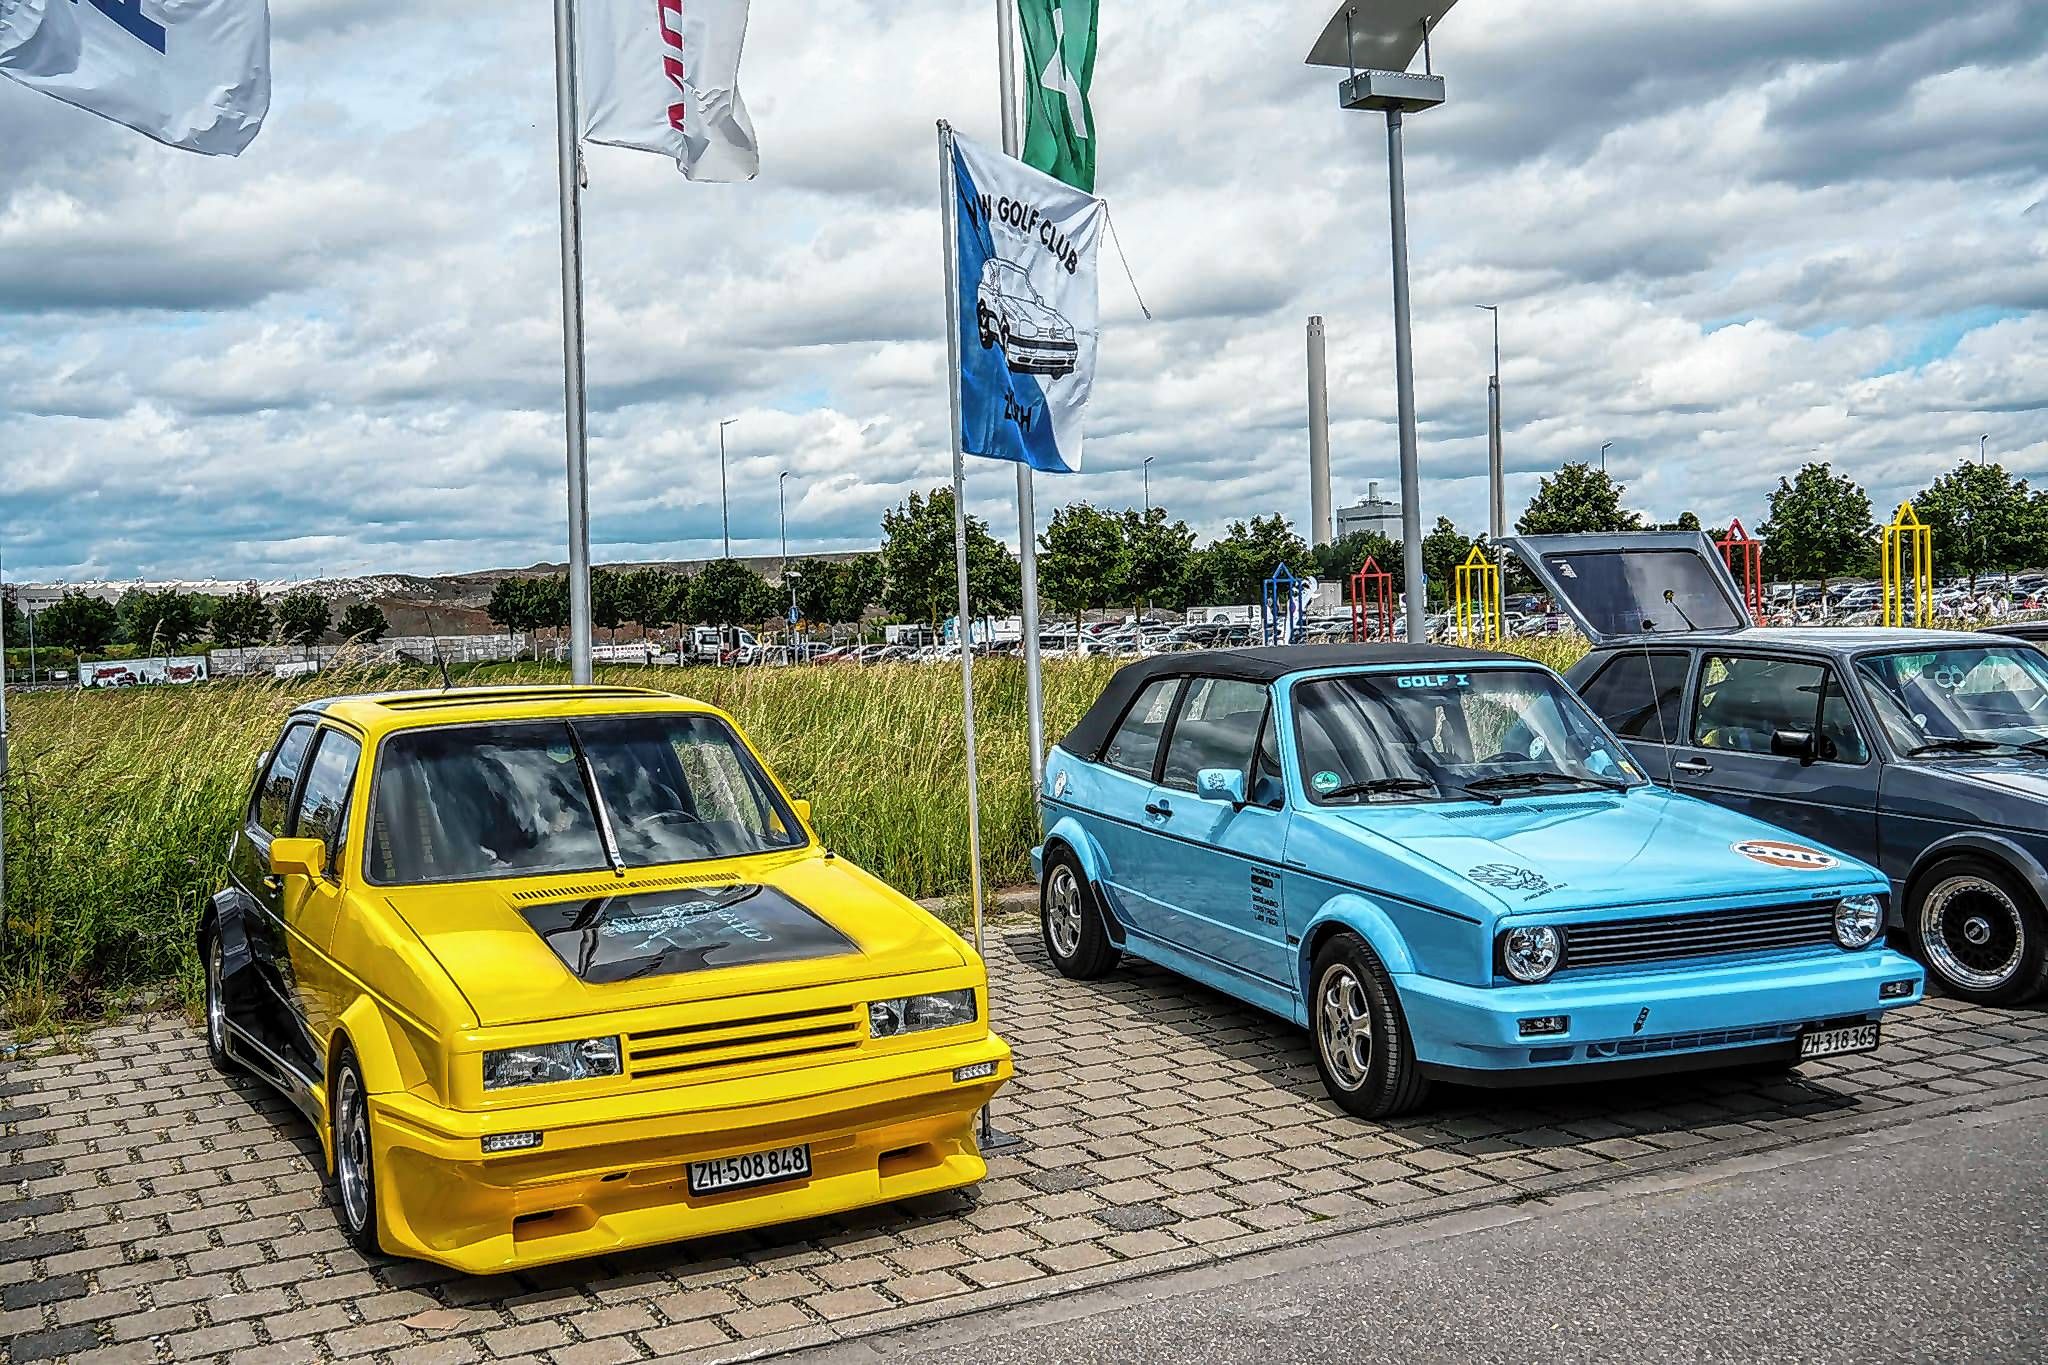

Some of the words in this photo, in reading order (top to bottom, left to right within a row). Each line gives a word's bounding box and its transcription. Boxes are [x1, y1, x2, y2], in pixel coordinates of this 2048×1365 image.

[965, 193, 992, 228] VW
[997, 195, 1040, 234] GOLF
[1039, 218, 1078, 275] CLUB
[1397, 674, 1449, 688] GOLF
[1454, 674, 1470, 686] I
